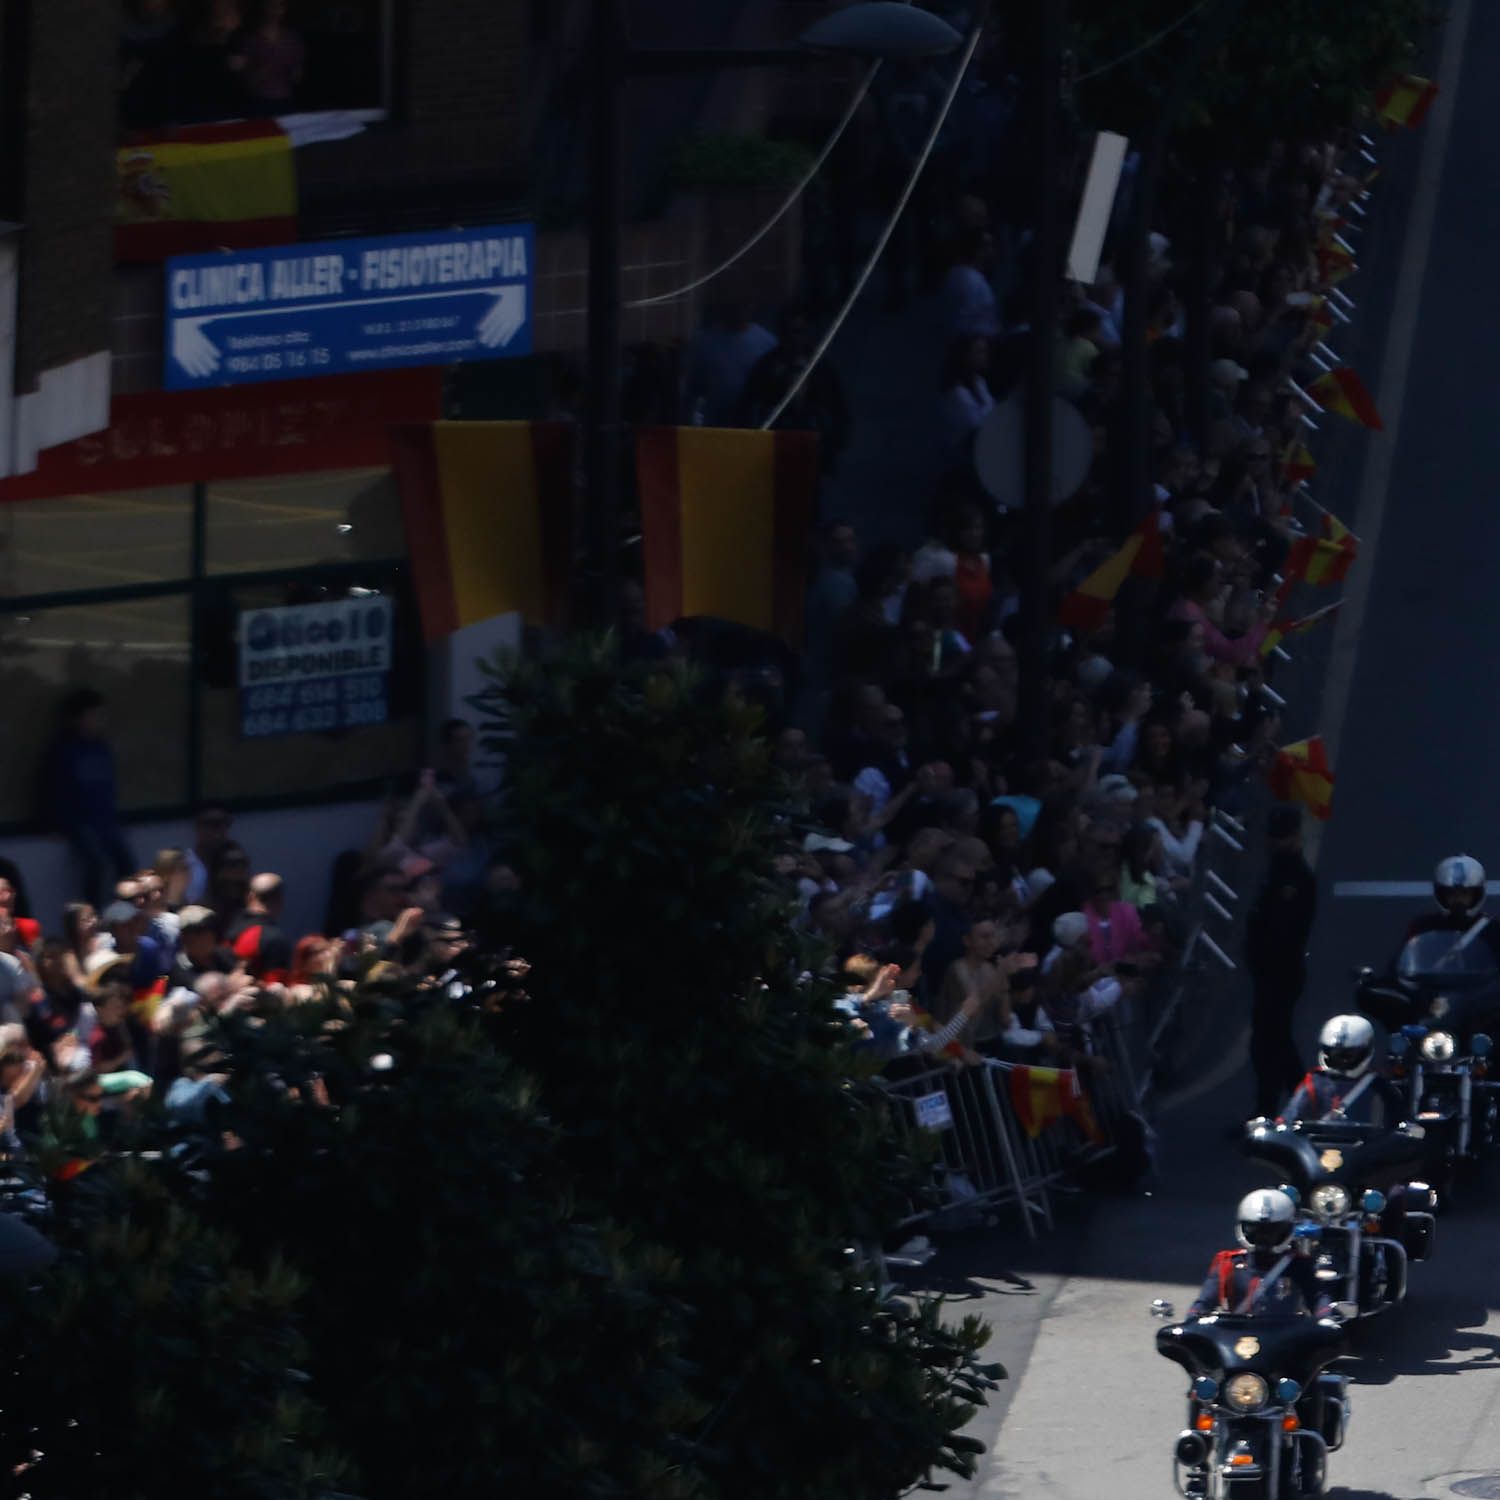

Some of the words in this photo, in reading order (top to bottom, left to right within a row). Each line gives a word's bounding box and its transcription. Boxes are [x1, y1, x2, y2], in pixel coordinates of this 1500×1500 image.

[172, 264, 265, 309] CLINICA
[270, 255, 343, 299] ALLER
[361, 237, 527, 291] FISIOTERAPIA
[248, 646, 385, 681] DISPONIBLE
